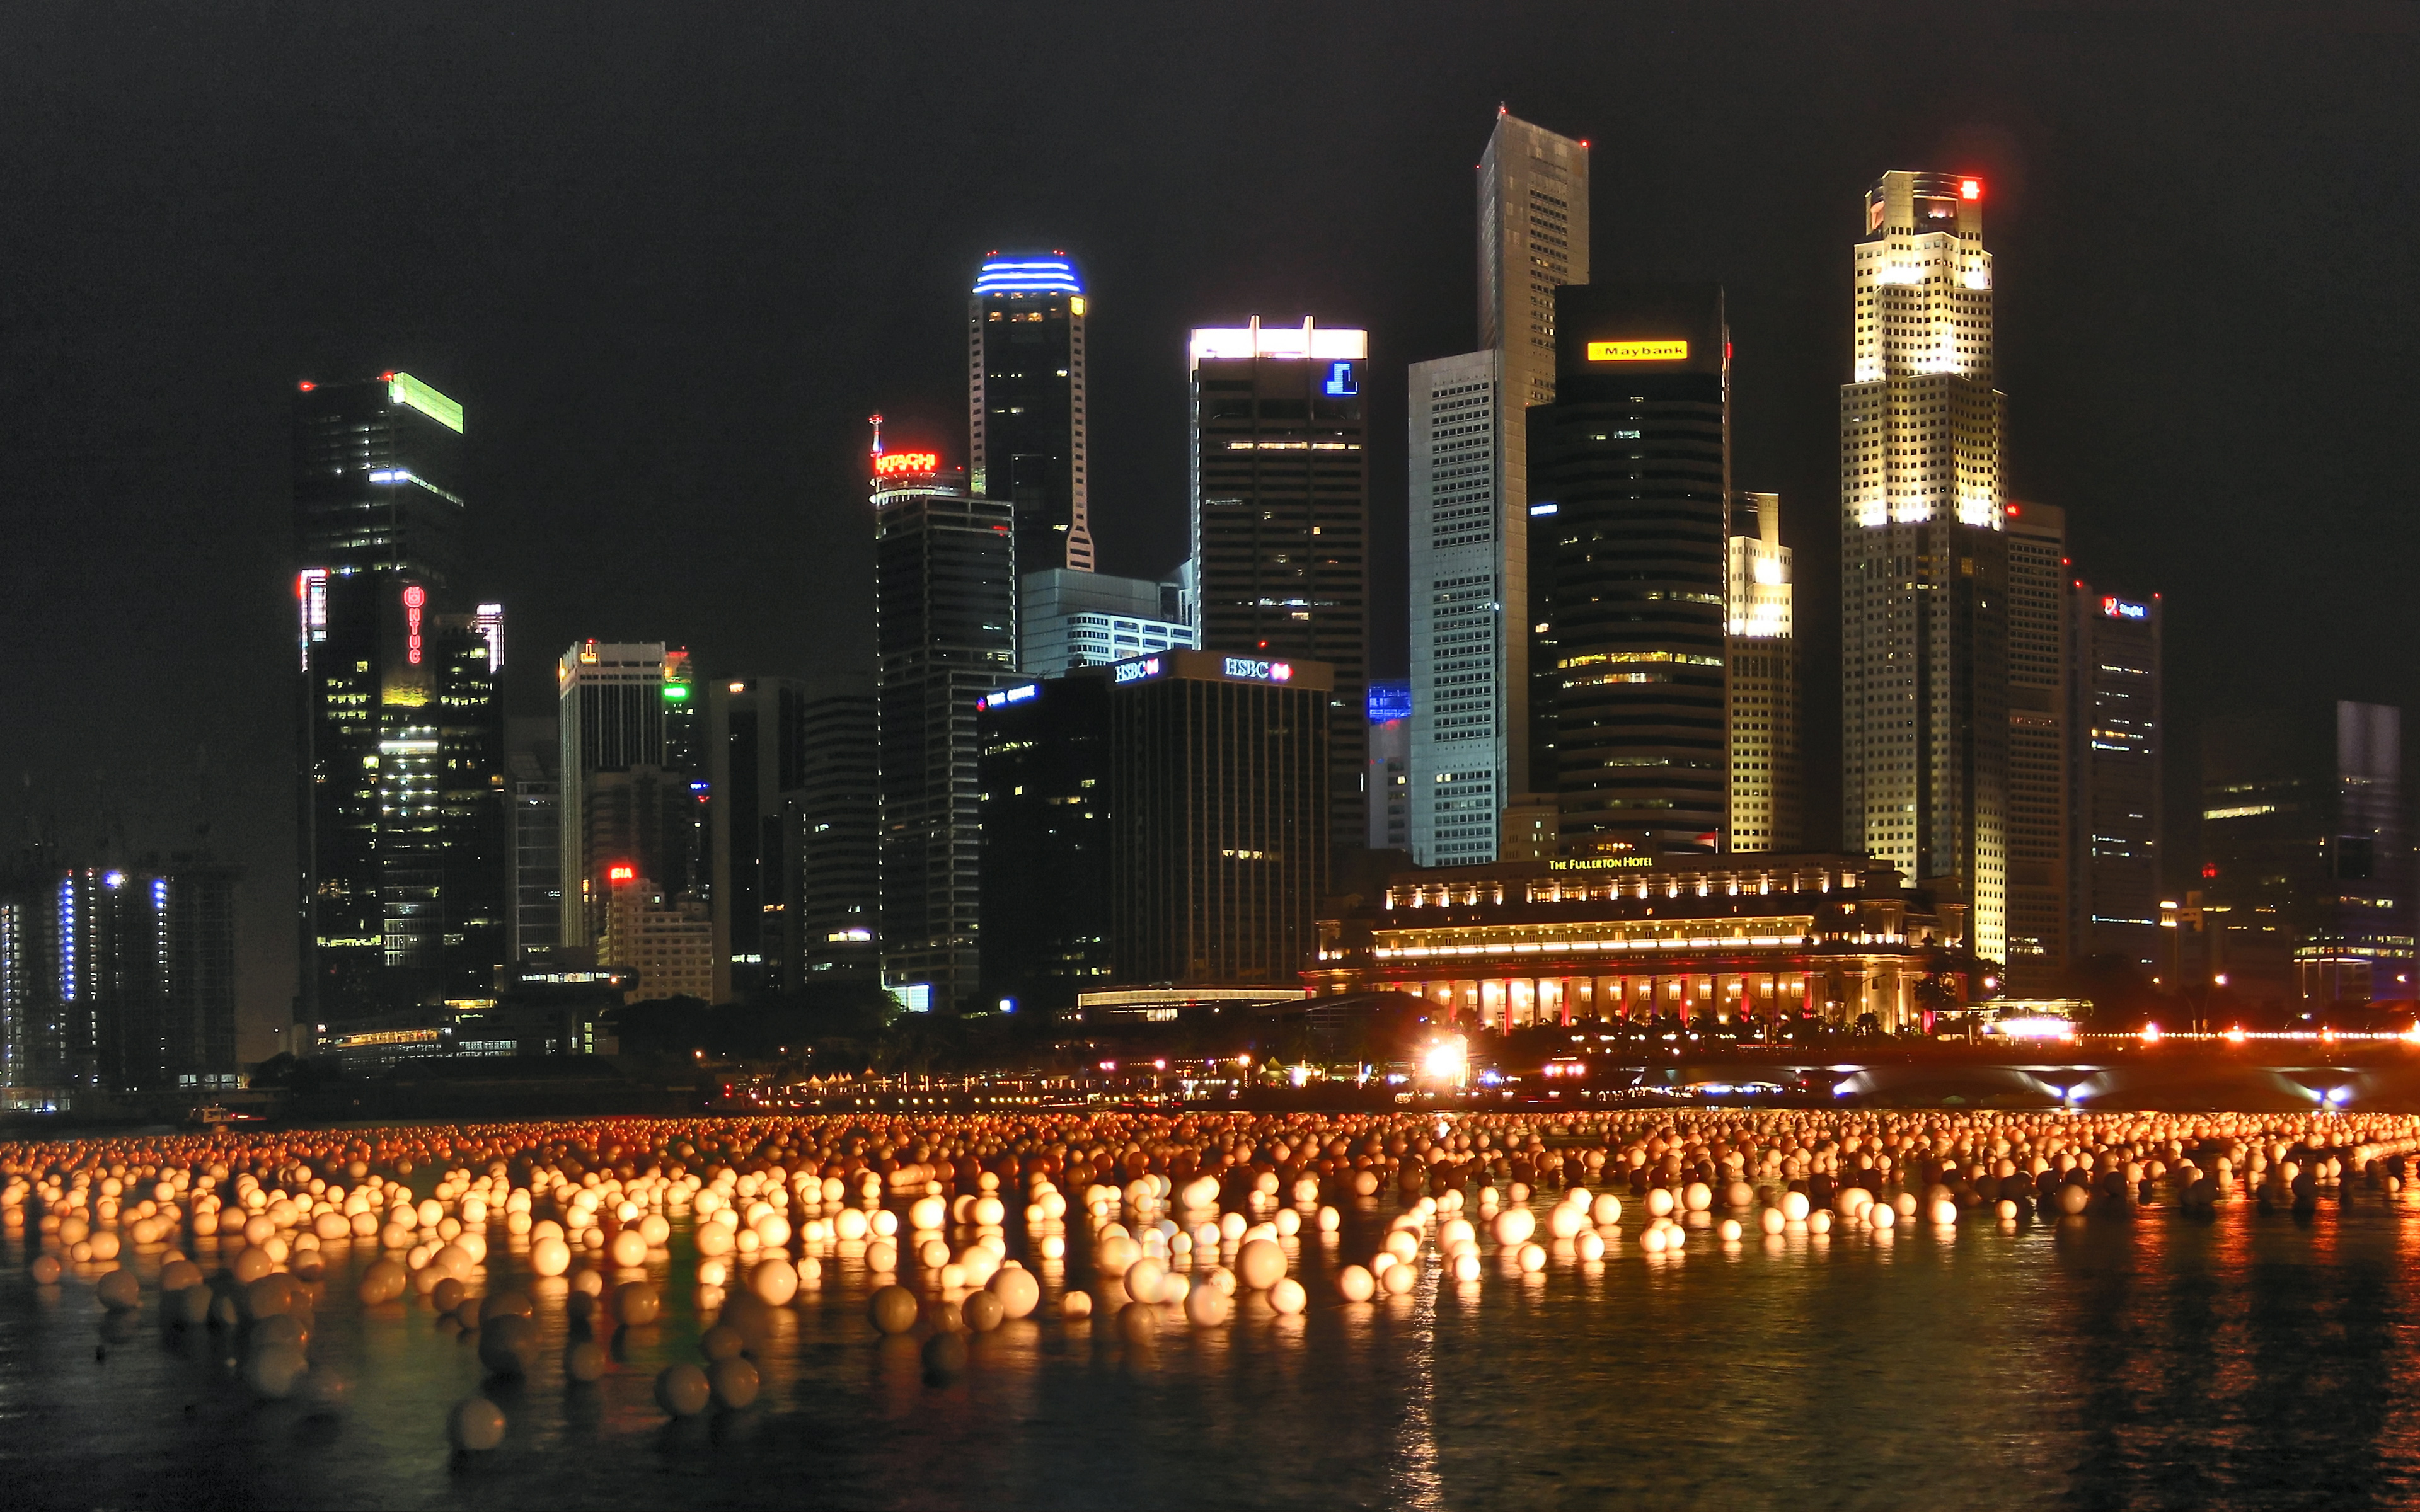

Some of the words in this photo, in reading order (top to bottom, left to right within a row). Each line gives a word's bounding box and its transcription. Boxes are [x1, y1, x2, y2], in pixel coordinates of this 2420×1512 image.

[1605, 347, 1683, 357] Maybank
[876, 453, 936, 471] HITACHI
[409, 607, 421, 664] NTUC
[1114, 659, 1146, 683] HSBC
[1224, 657, 1269, 679] HSBC
[1549, 860, 1567, 870] THE
[1569, 858, 1622, 869] FULLERTON
[1623, 857, 1652, 868] HOTEL
